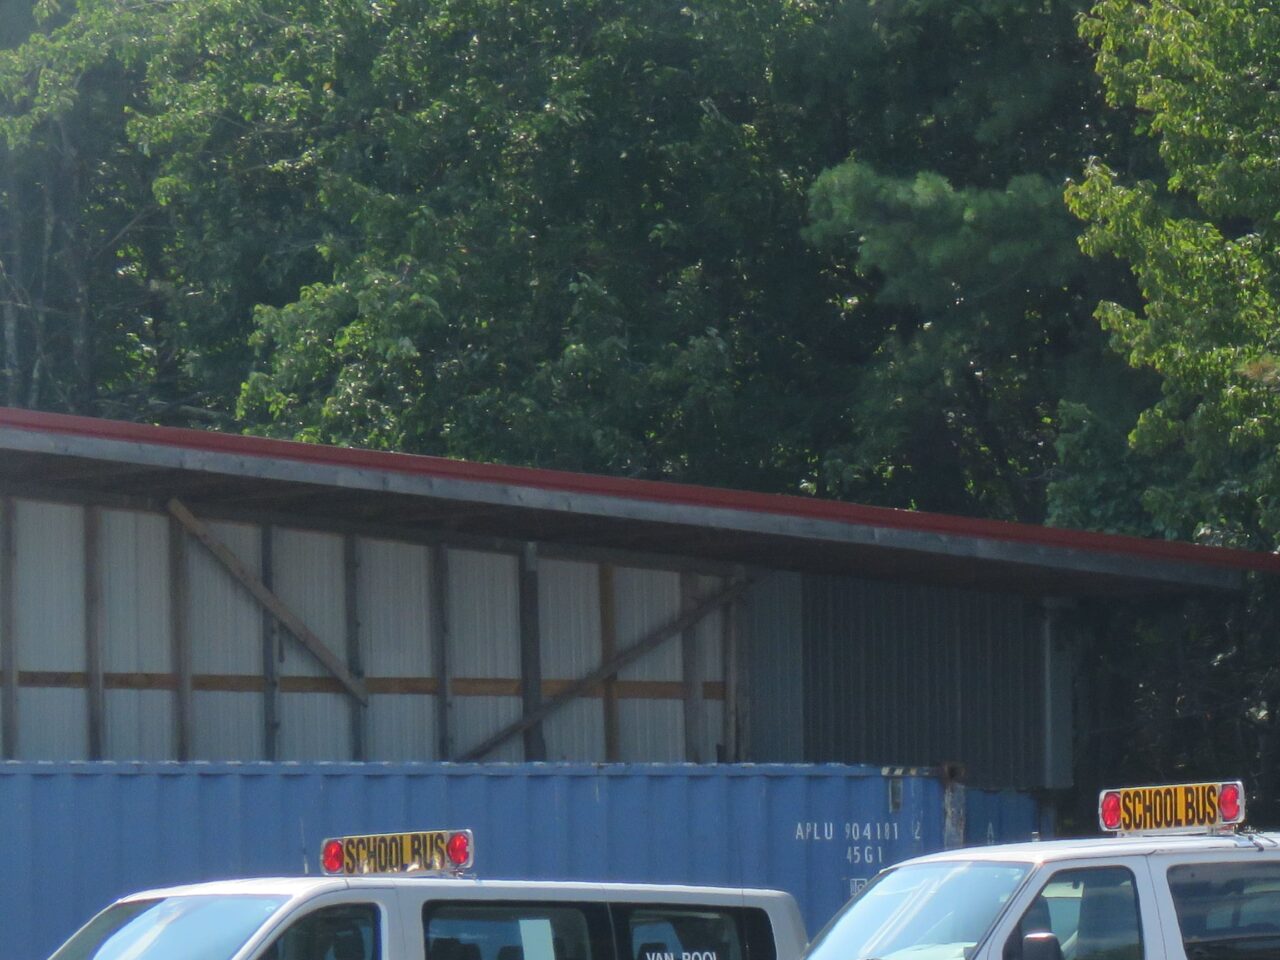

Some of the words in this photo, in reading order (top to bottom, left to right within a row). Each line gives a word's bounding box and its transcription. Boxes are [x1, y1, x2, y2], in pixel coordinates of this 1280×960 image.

[1122, 788, 1182, 831] SCHOOL
[1184, 785, 1217, 826] BUS
[796, 822, 833, 840] APLU
[845, 822, 898, 840] 904181
[345, 836, 407, 874] SCHOOL
[410, 833, 445, 870] BUS
[847, 846, 882, 863] 45G1
